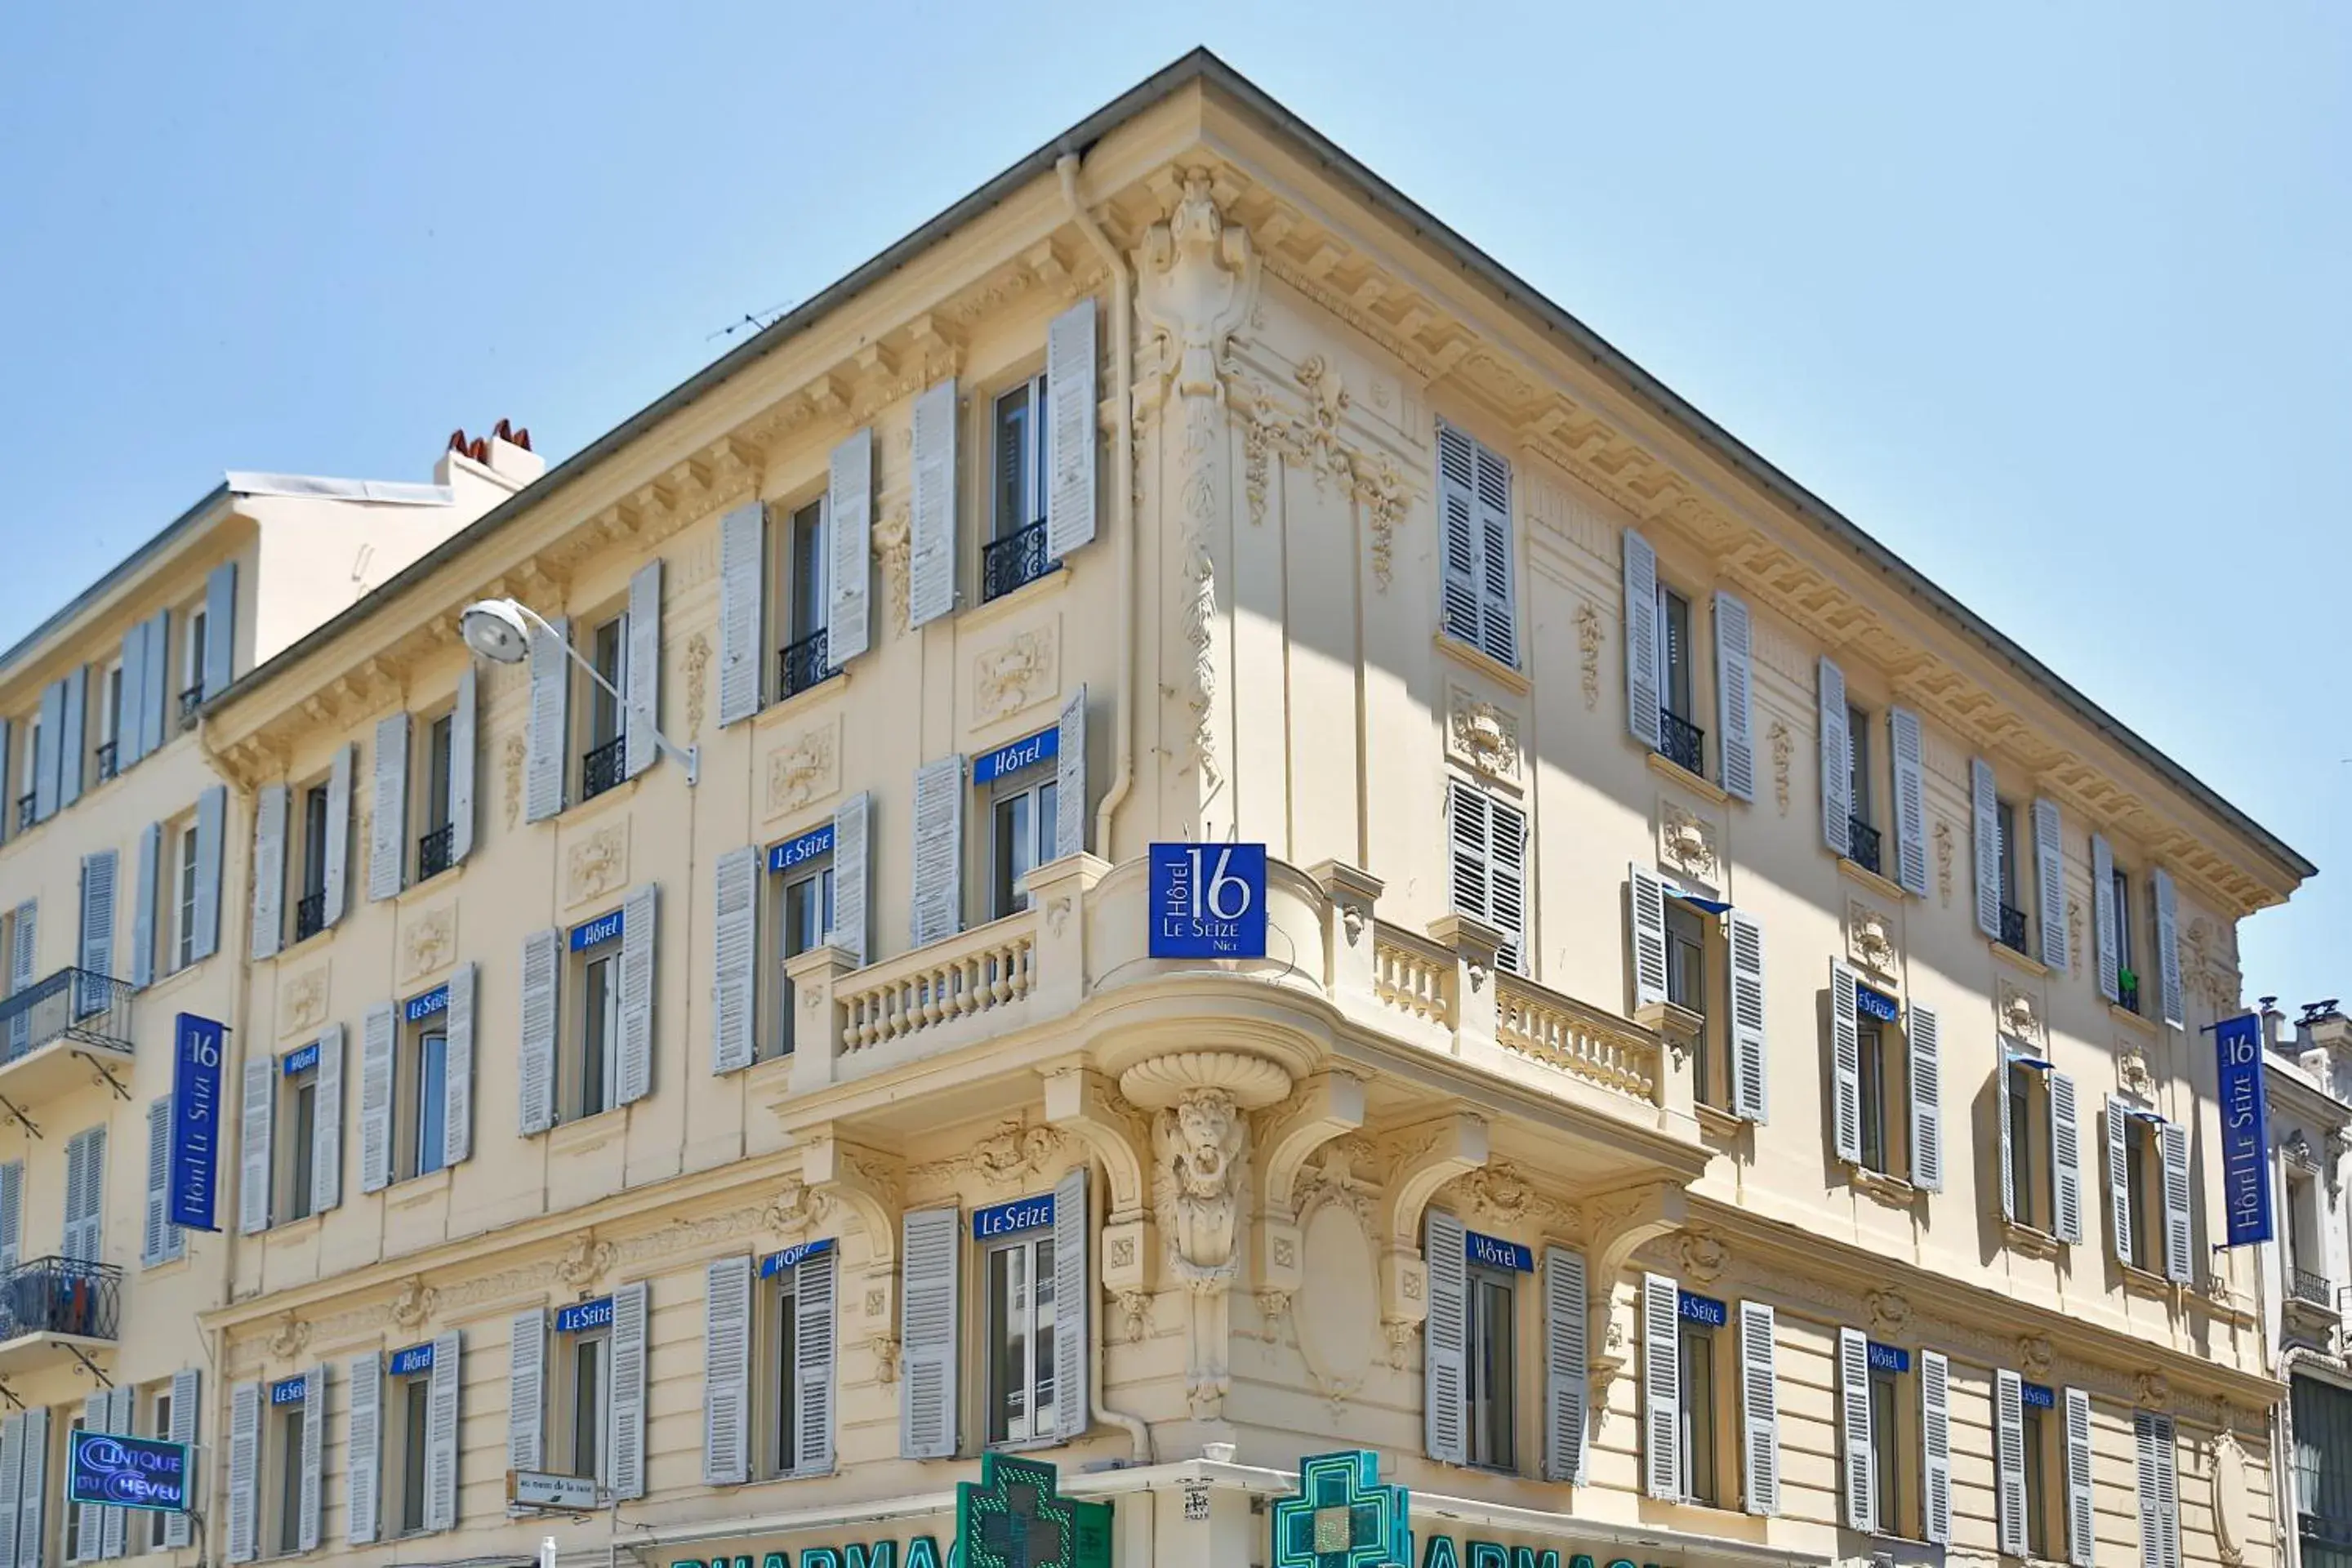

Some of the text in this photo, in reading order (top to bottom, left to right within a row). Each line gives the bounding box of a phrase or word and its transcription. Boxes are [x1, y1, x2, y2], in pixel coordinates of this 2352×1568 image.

[995, 737, 1040, 776] HÔTEL
[777, 848, 793, 867] LE
[1187, 848, 1251, 920] 16
[1164, 917, 1183, 937] LE
[193, 1031, 219, 1067] 16
[2228, 1033, 2255, 1066] 16
[2232, 1136, 2255, 1160] LE
[982, 1212, 1003, 1235] LE
[565, 1310, 579, 1330] LE
[79, 1437, 181, 1473] CLINIQUE
[77, 1469, 181, 1503] DU CHEVEU
